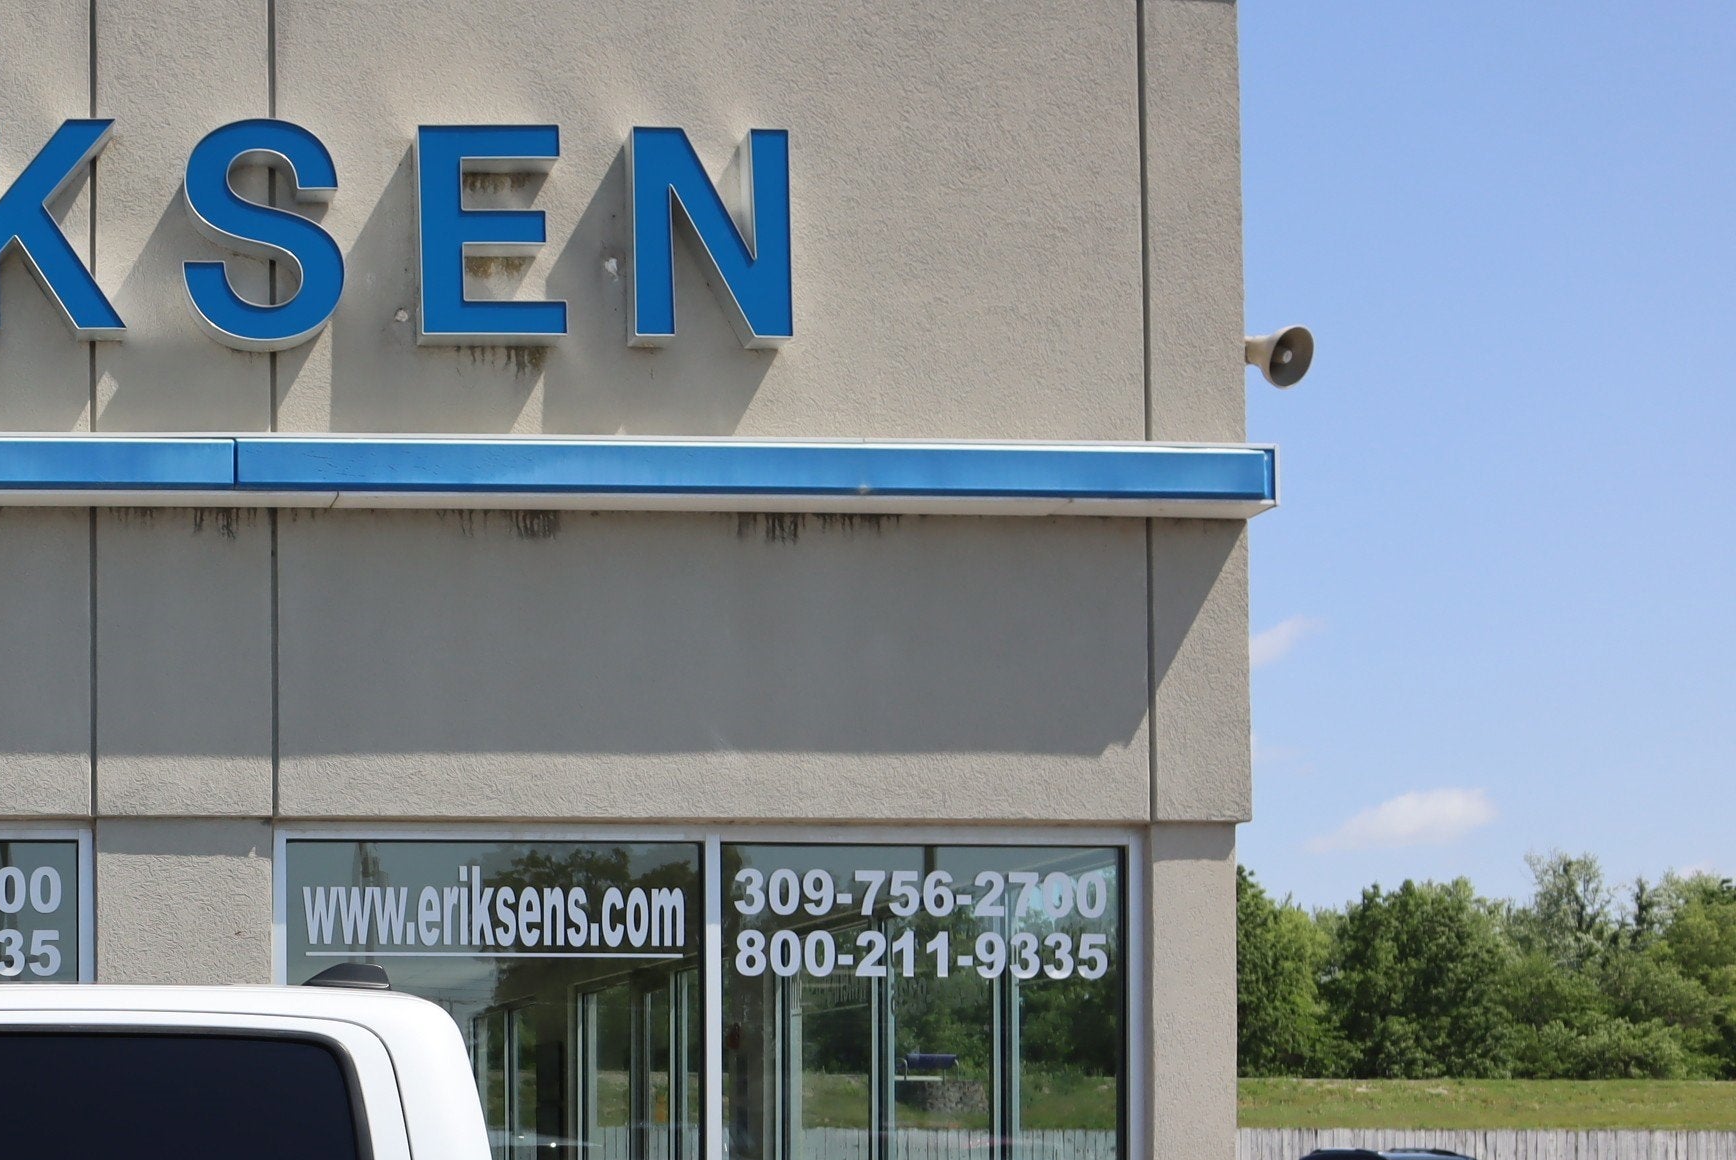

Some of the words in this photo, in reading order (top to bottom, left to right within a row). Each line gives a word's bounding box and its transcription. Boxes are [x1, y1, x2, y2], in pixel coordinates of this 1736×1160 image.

[303, 866, 686, 948] www.eriksens.com
[734, 868, 1108, 920] 309-756-2700
[734, 930, 1109, 980] 800-211-9335
